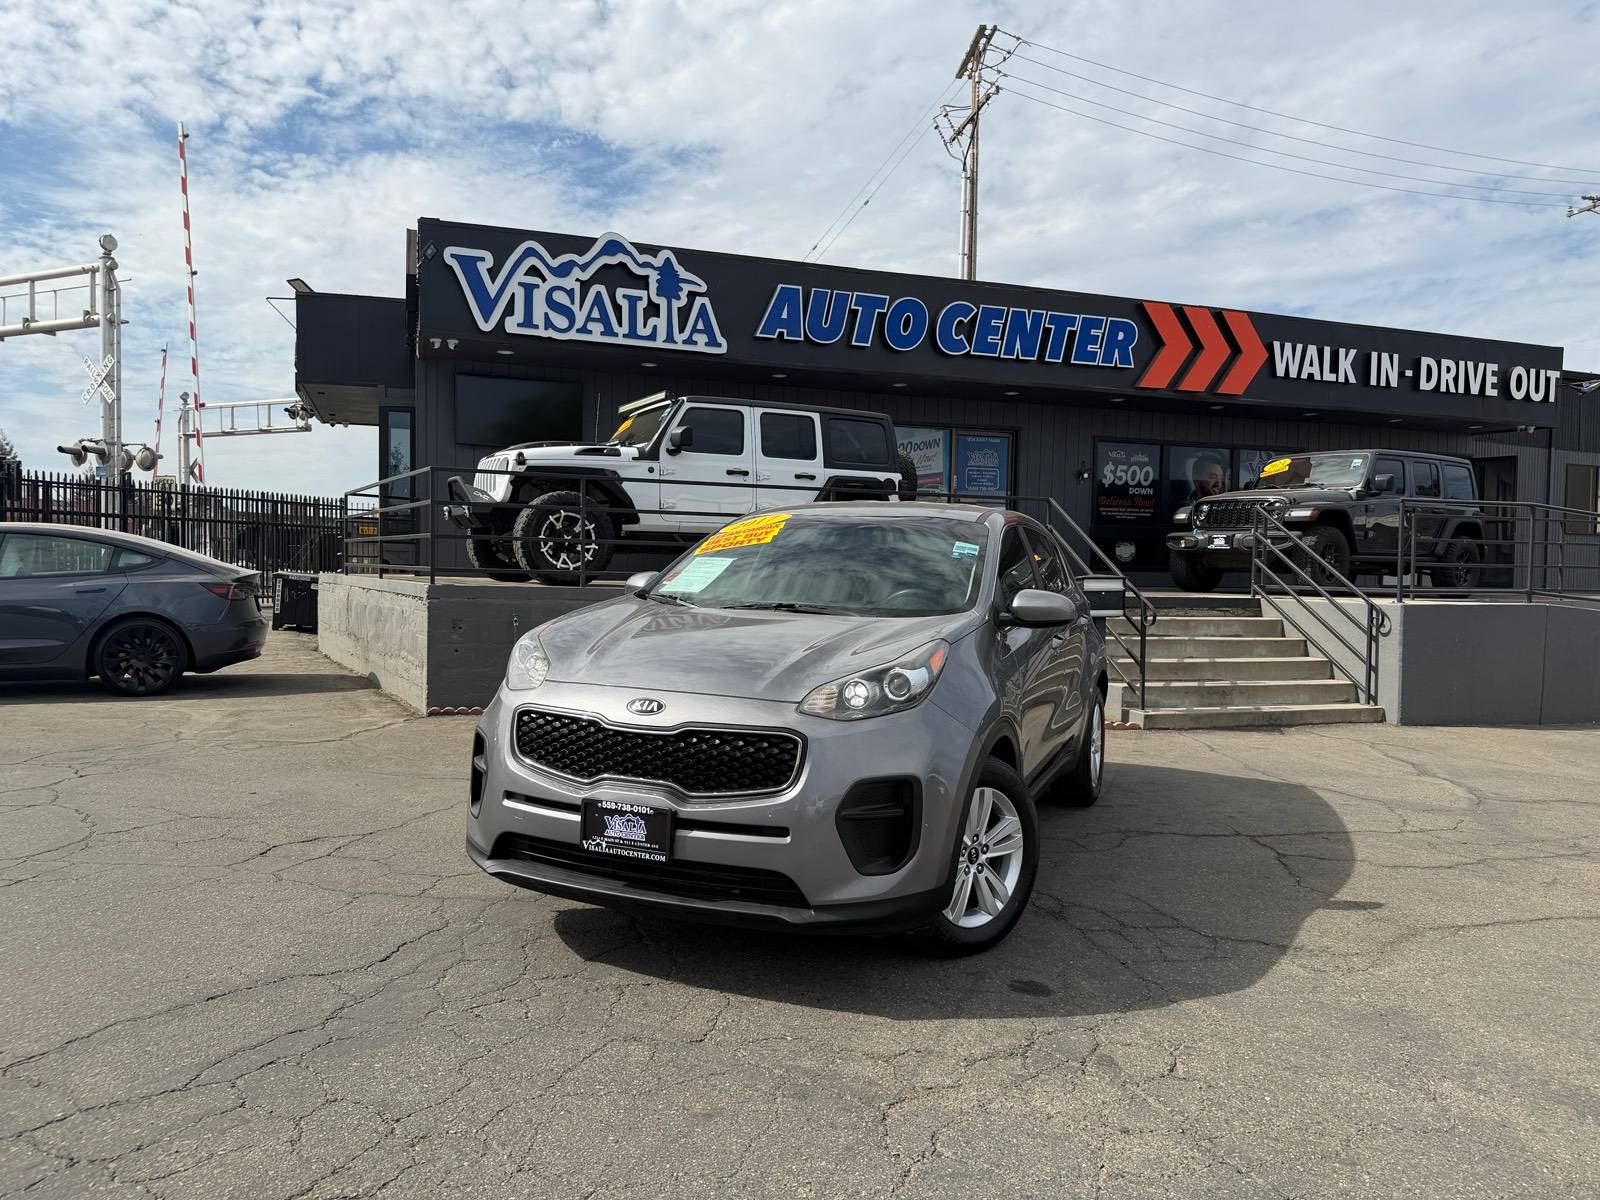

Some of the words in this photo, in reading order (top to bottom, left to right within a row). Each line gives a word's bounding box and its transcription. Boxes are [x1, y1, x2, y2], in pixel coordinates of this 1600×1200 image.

[443, 232, 727, 354] VISALIA
[756, 283, 929, 351] AUTO
[936, 301, 1138, 368] CENTER
[82, 357, 113, 401] CROSSING
[1272, 340, 1357, 383] WALK
[1509, 365, 1560, 402] OUT
[914, 437, 941, 452] DOWN
[1102, 461, 1154, 487] $500
[1129, 487, 1154, 495] DOWN
[700, 537, 769, 553] SPORTY
[706, 535, 740, 546] BEST
[743, 530, 774, 540] BUY
[630, 700, 658, 711] KIA
[602, 801, 650, 814] 559-738-0101
[604, 814, 647, 834] VISALIA
